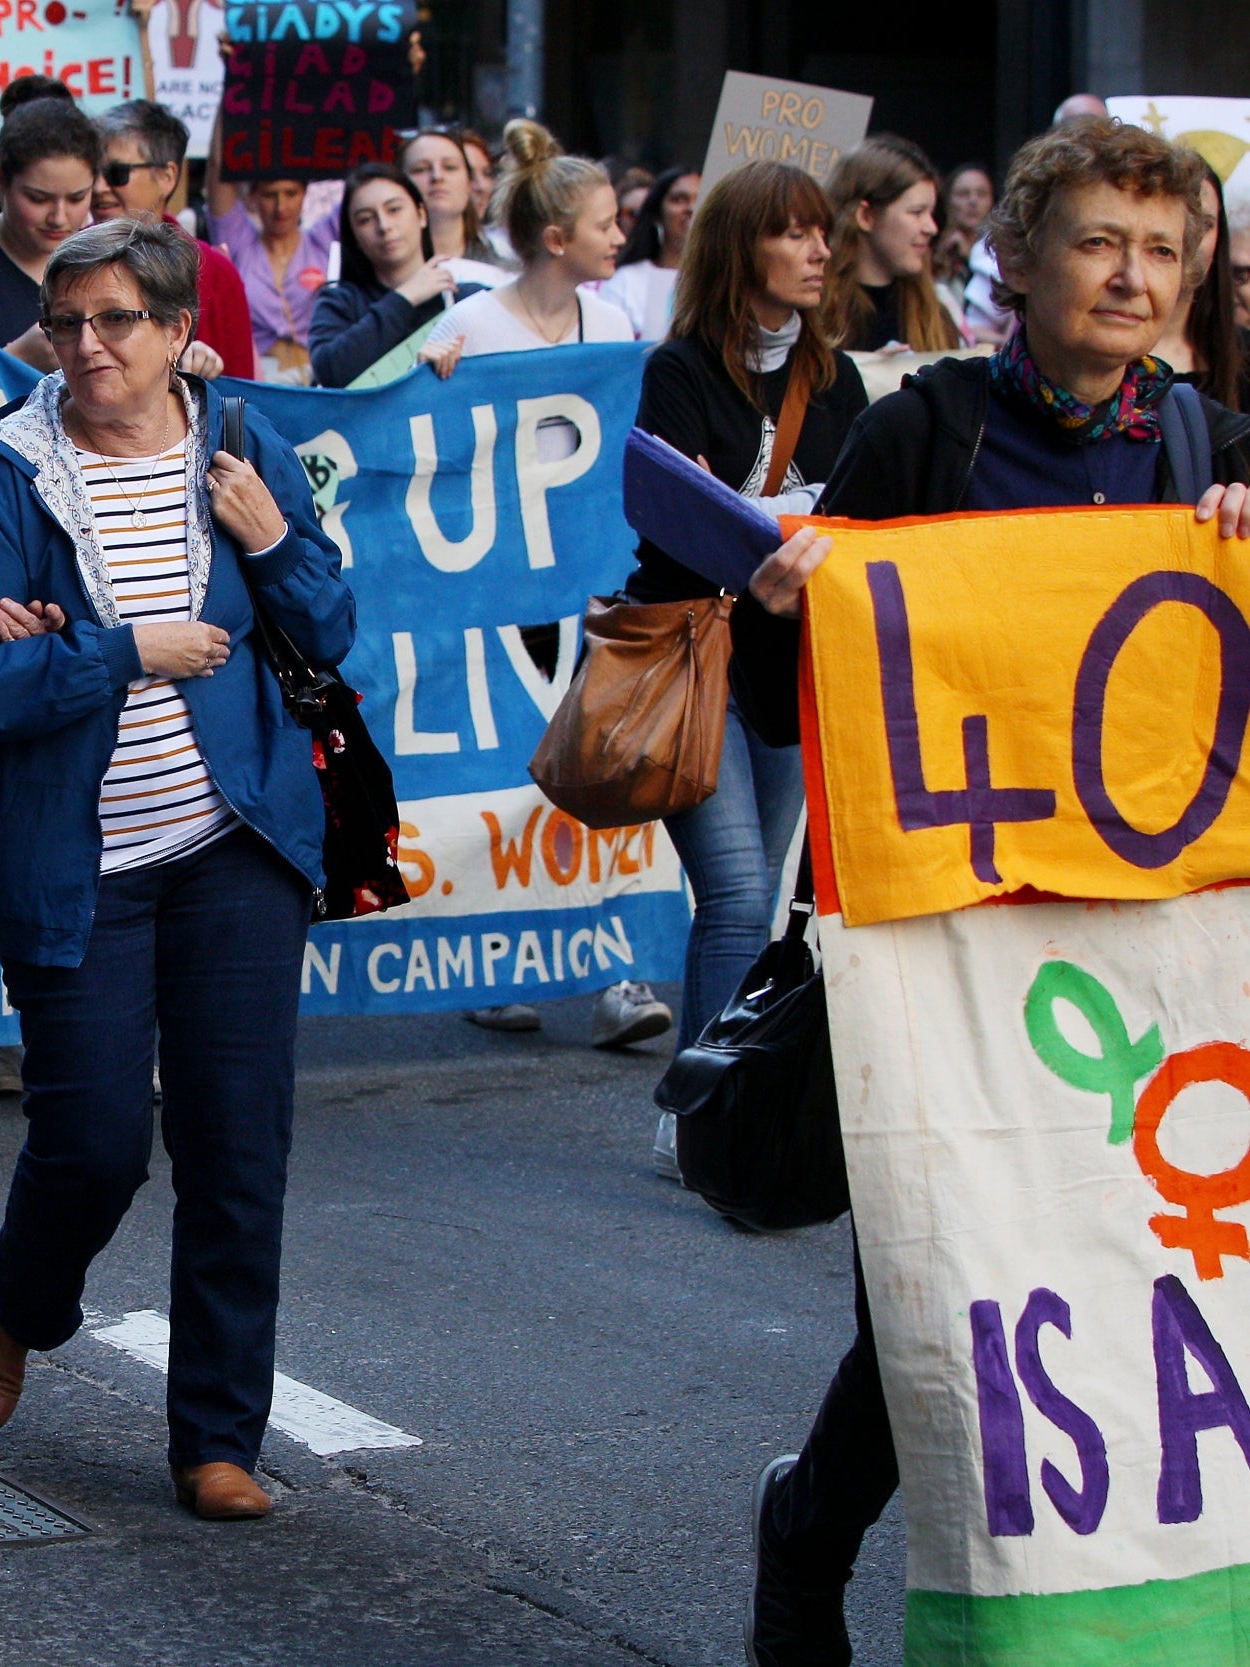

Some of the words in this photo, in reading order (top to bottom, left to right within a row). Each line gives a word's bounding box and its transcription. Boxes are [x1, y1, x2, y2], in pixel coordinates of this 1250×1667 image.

[762, 90, 826, 129] PRO
[406, 393, 601, 573] UP
[865, 560, 1250, 885] 40
[969, 1286, 1110, 1537] IS
[1152, 1273, 1250, 1525] A
